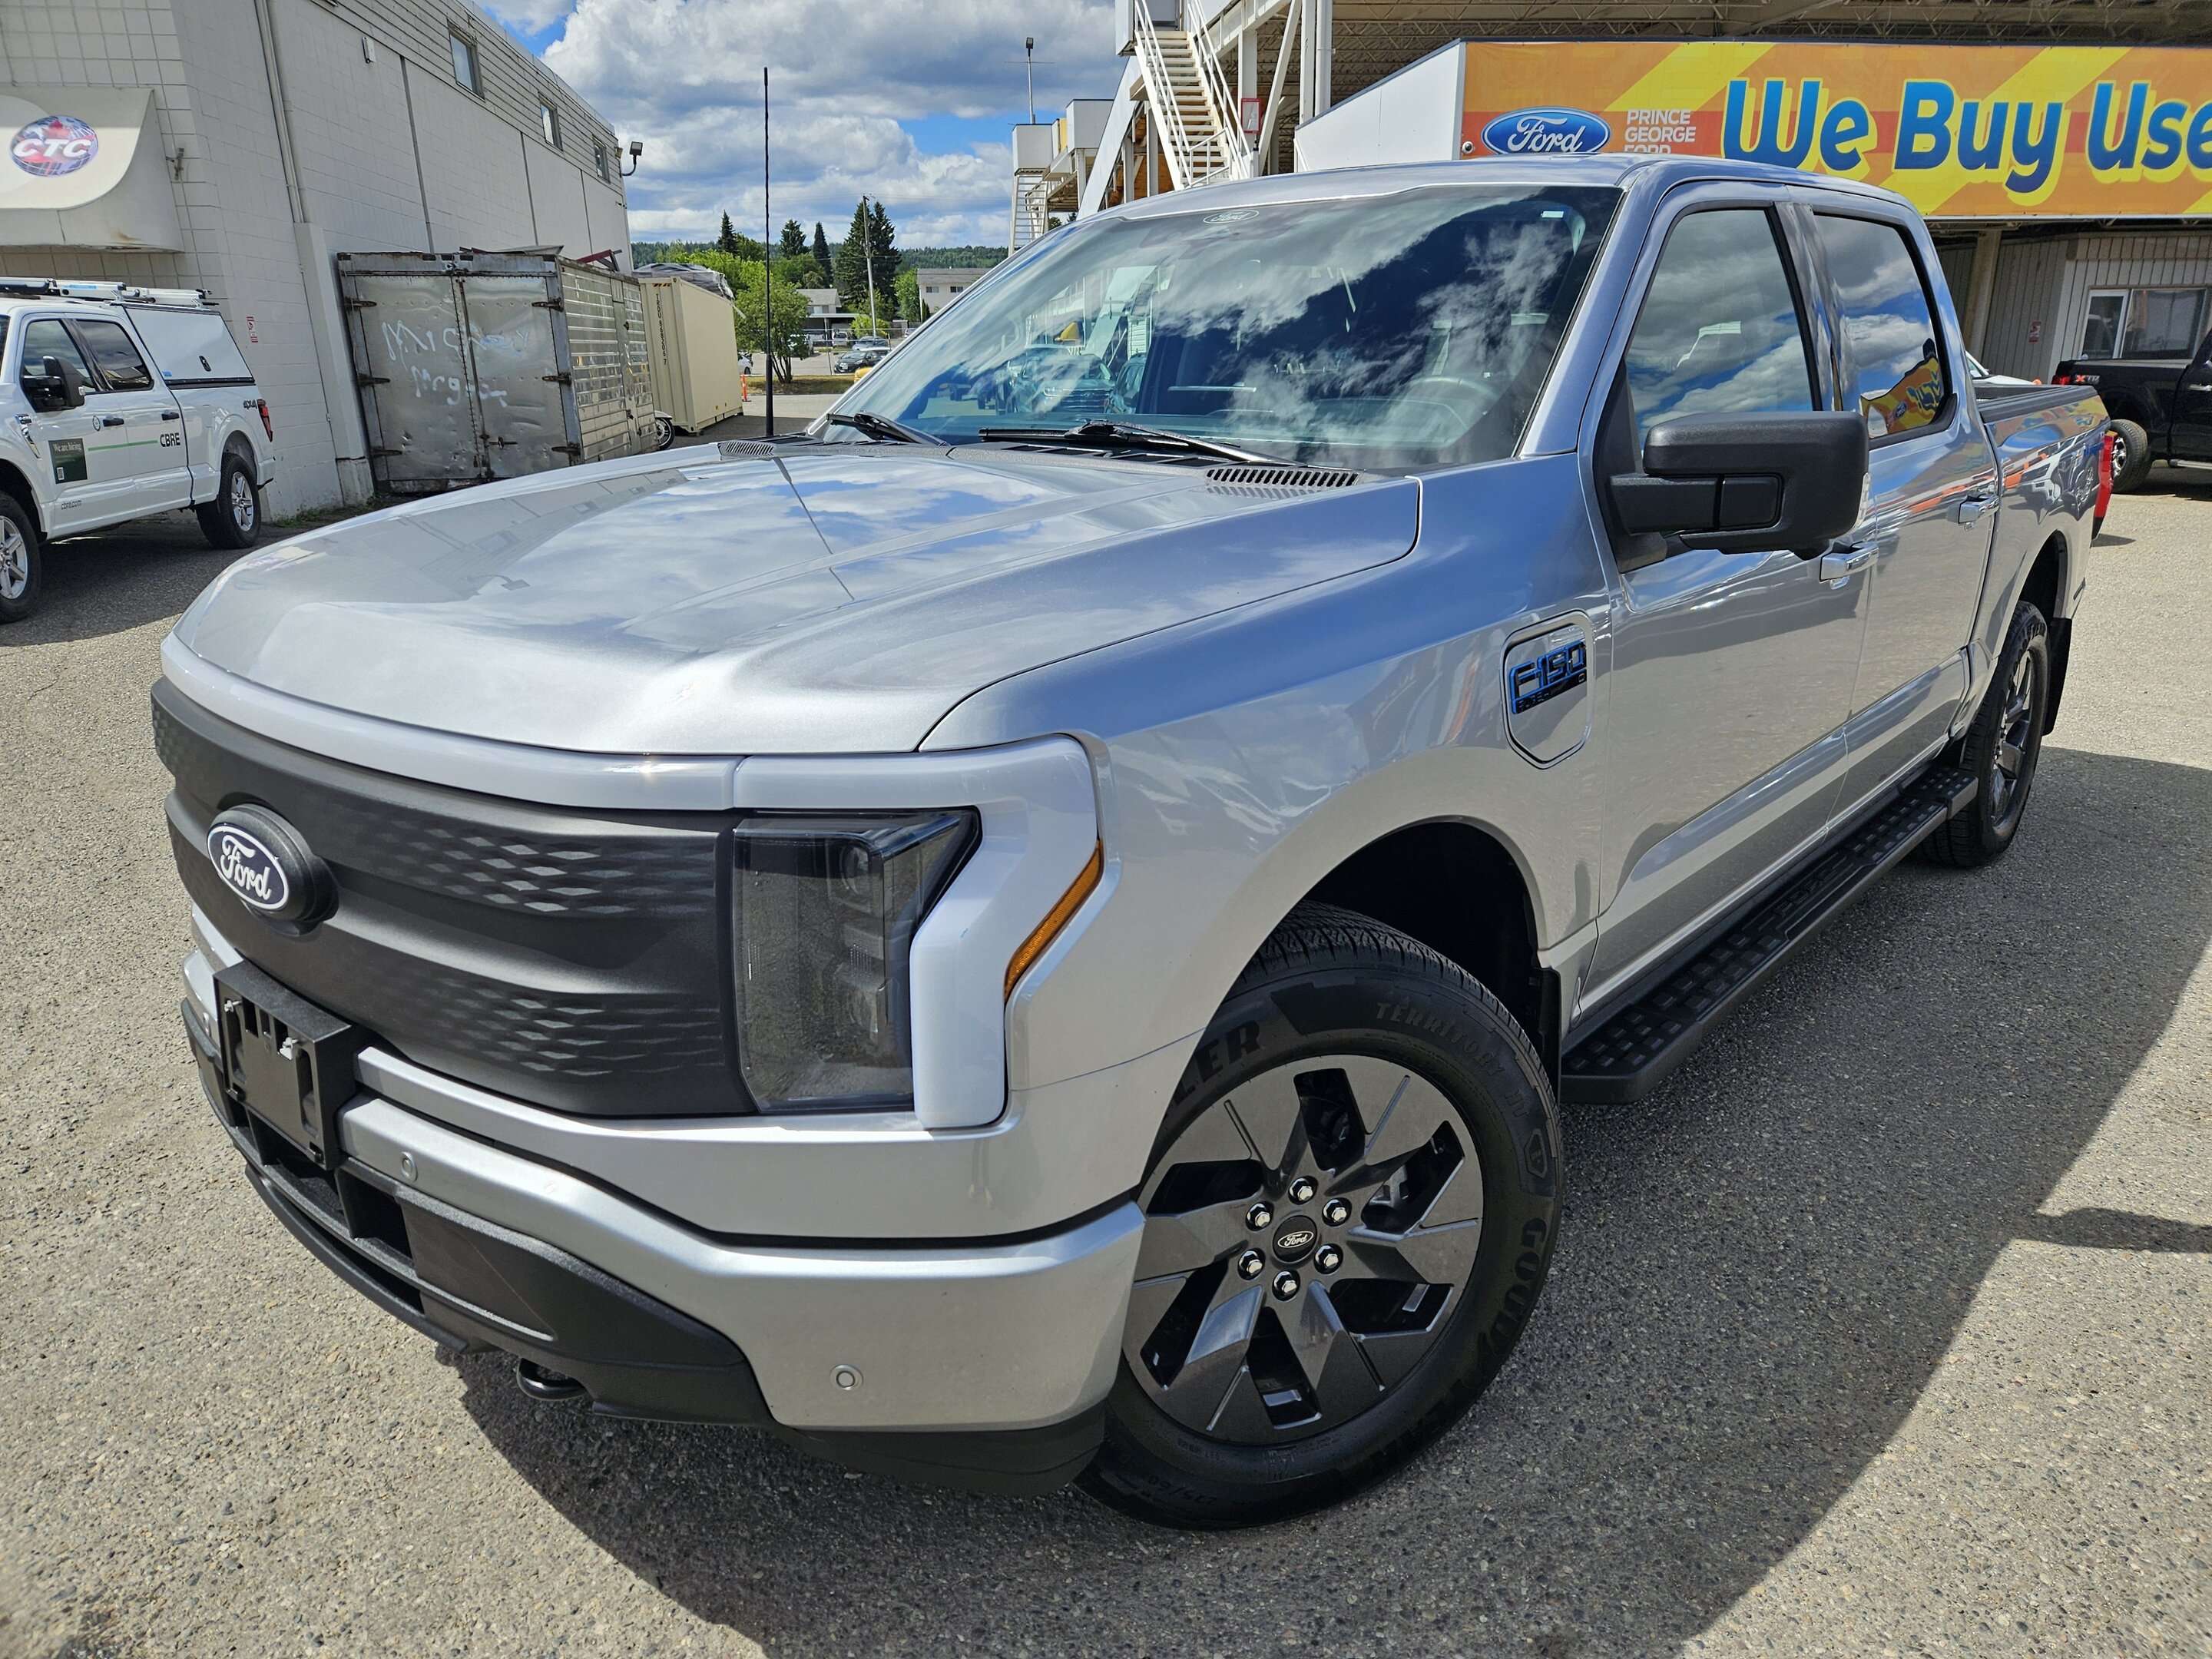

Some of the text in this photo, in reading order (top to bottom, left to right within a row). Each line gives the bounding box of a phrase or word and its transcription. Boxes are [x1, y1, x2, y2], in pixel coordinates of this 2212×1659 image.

[1627, 109, 1690, 125] PRINCE
[1507, 116, 1585, 153] Ford
[1624, 126, 1697, 143] GEORGE
[1724, 81, 1869, 171] We
[1894, 81, 2062, 194] Buy
[13, 138, 91, 157] CTC
[160, 432, 180, 447] CBRE
[220, 834, 272, 900] Ford
